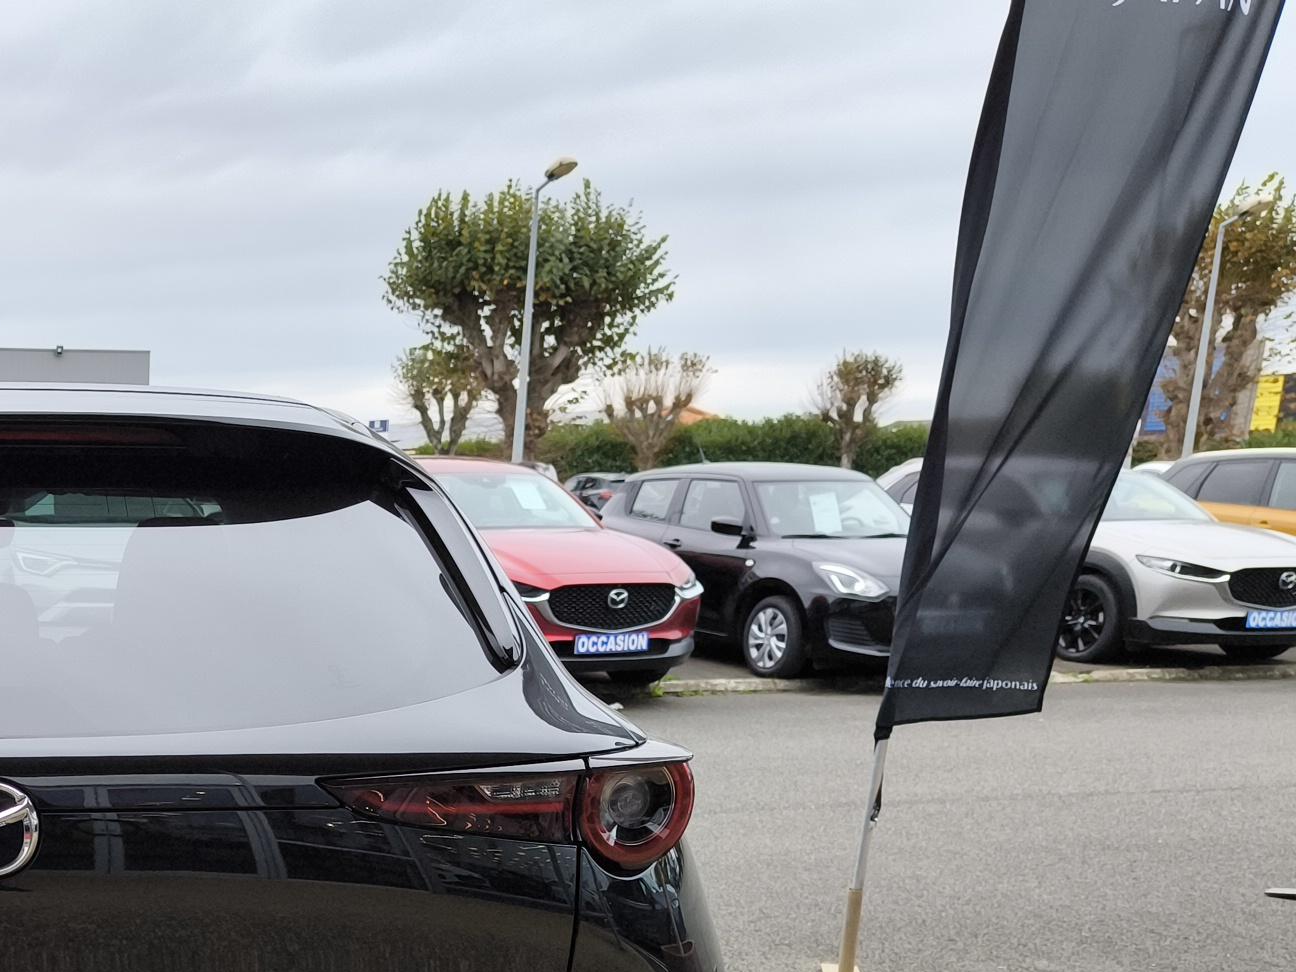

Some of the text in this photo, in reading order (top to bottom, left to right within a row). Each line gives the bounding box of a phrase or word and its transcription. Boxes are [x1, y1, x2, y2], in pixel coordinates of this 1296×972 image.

[577, 633, 648, 652] OCCASION
[912, 677, 927, 688] du
[982, 677, 1038, 691] japonais
